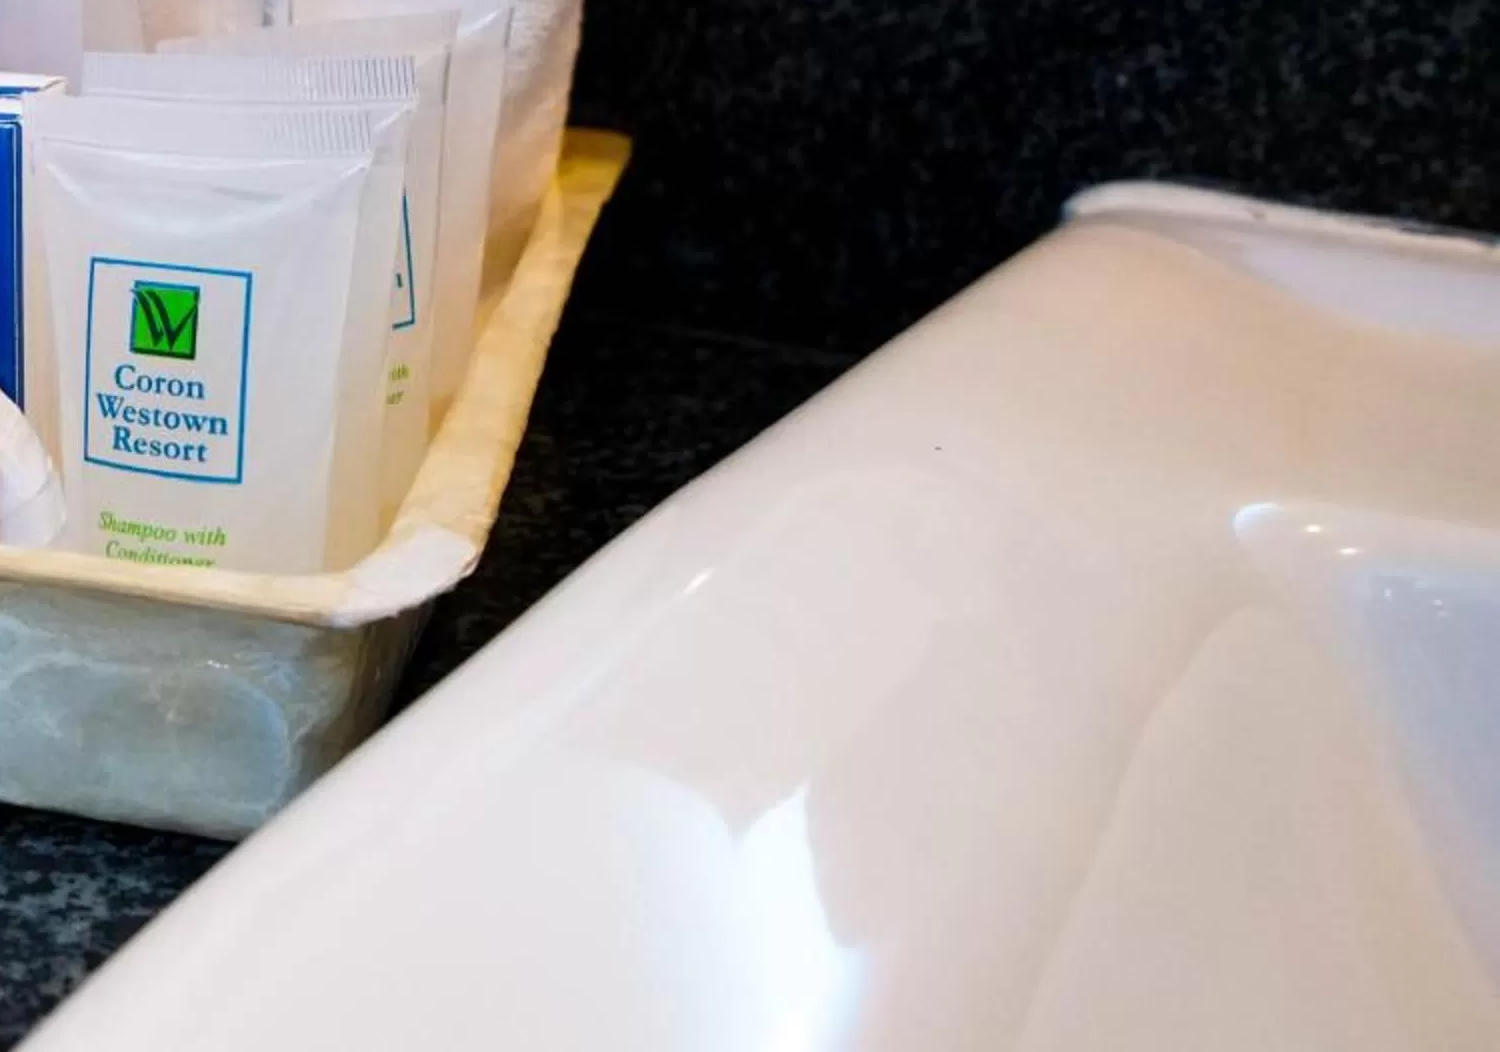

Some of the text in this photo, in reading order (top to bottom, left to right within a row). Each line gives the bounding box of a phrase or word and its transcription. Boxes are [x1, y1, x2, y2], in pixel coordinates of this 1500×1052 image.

[114, 364, 206, 399] Coron
[96, 392, 230, 436] Westown
[112, 425, 210, 463] Resort
[98, 510, 228, 547] Shampoo with
